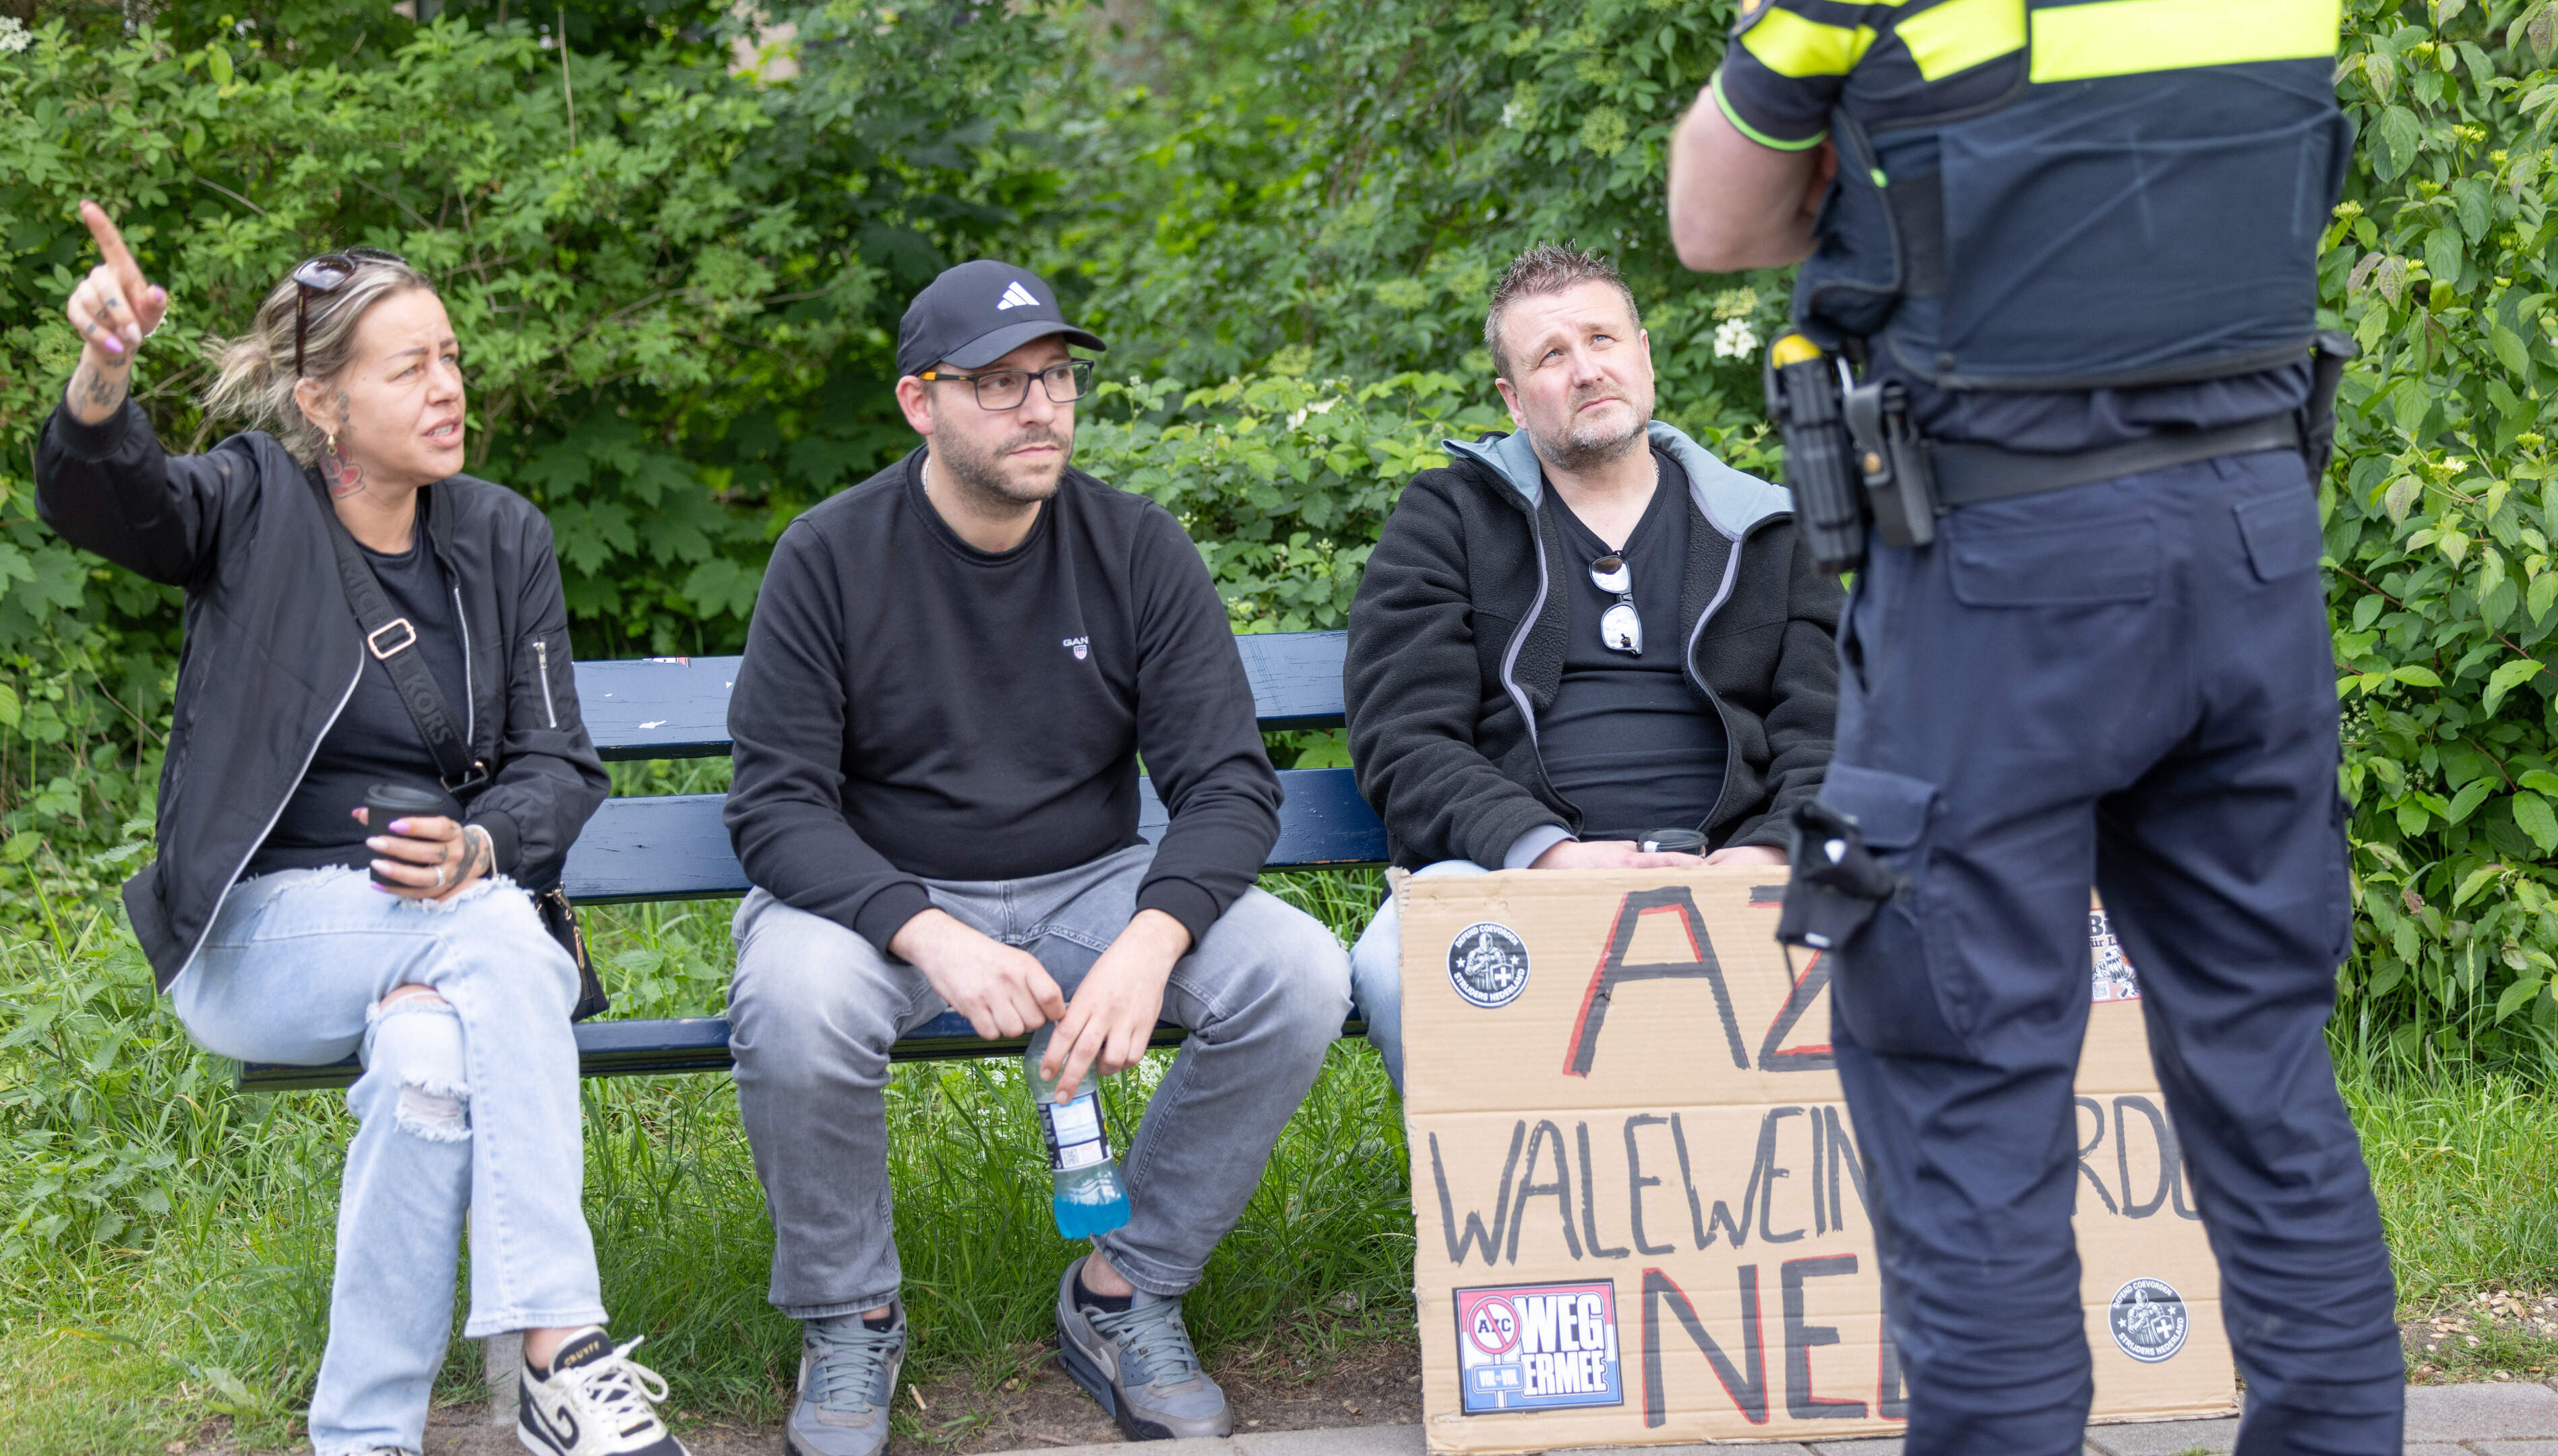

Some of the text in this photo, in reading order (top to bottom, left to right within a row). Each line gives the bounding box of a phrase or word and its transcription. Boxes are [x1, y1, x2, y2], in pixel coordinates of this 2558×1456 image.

[1063, 636, 1089, 646] GAN
[406, 673, 453, 744] KORS
[1455, 924, 1519, 948] DEFEND COEVORDEN
[1489, 968, 1525, 1002] NEDERLAND
[2112, 1280, 2172, 1309] DEFEND COEVORDEN
[1512, 1293, 1606, 1354] WEG
[2118, 1316, 2185, 1356] STRIJDERS NEDERLAND
[1520, 1349, 1608, 1395] ERMEE
